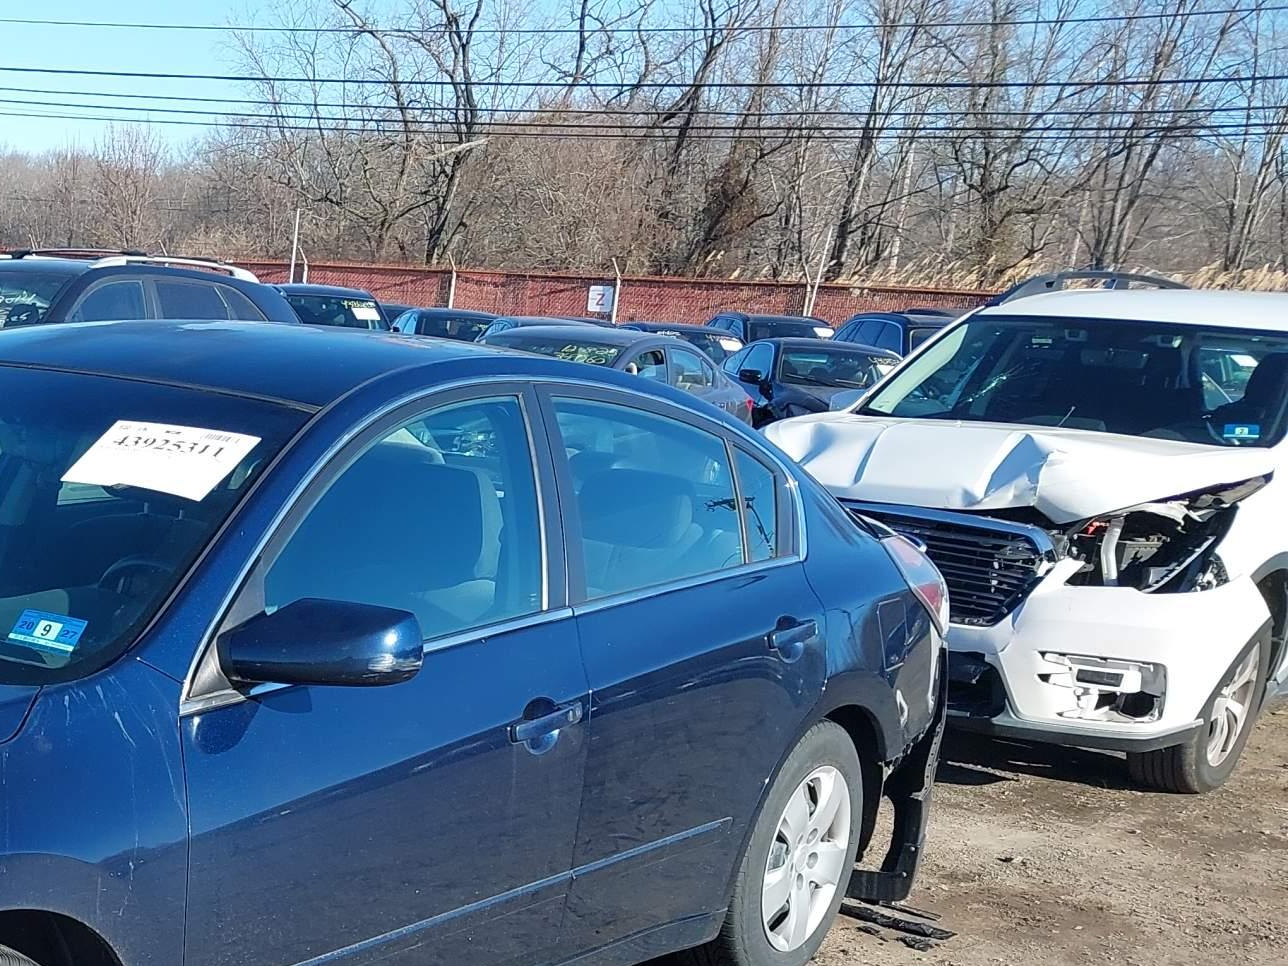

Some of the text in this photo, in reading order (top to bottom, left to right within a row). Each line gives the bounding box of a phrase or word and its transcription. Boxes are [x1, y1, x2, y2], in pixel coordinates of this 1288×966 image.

[595, 292, 606, 306] Z
[113, 435, 225, 457] 43925311
[18, 620, 78, 640] 20 9 27
